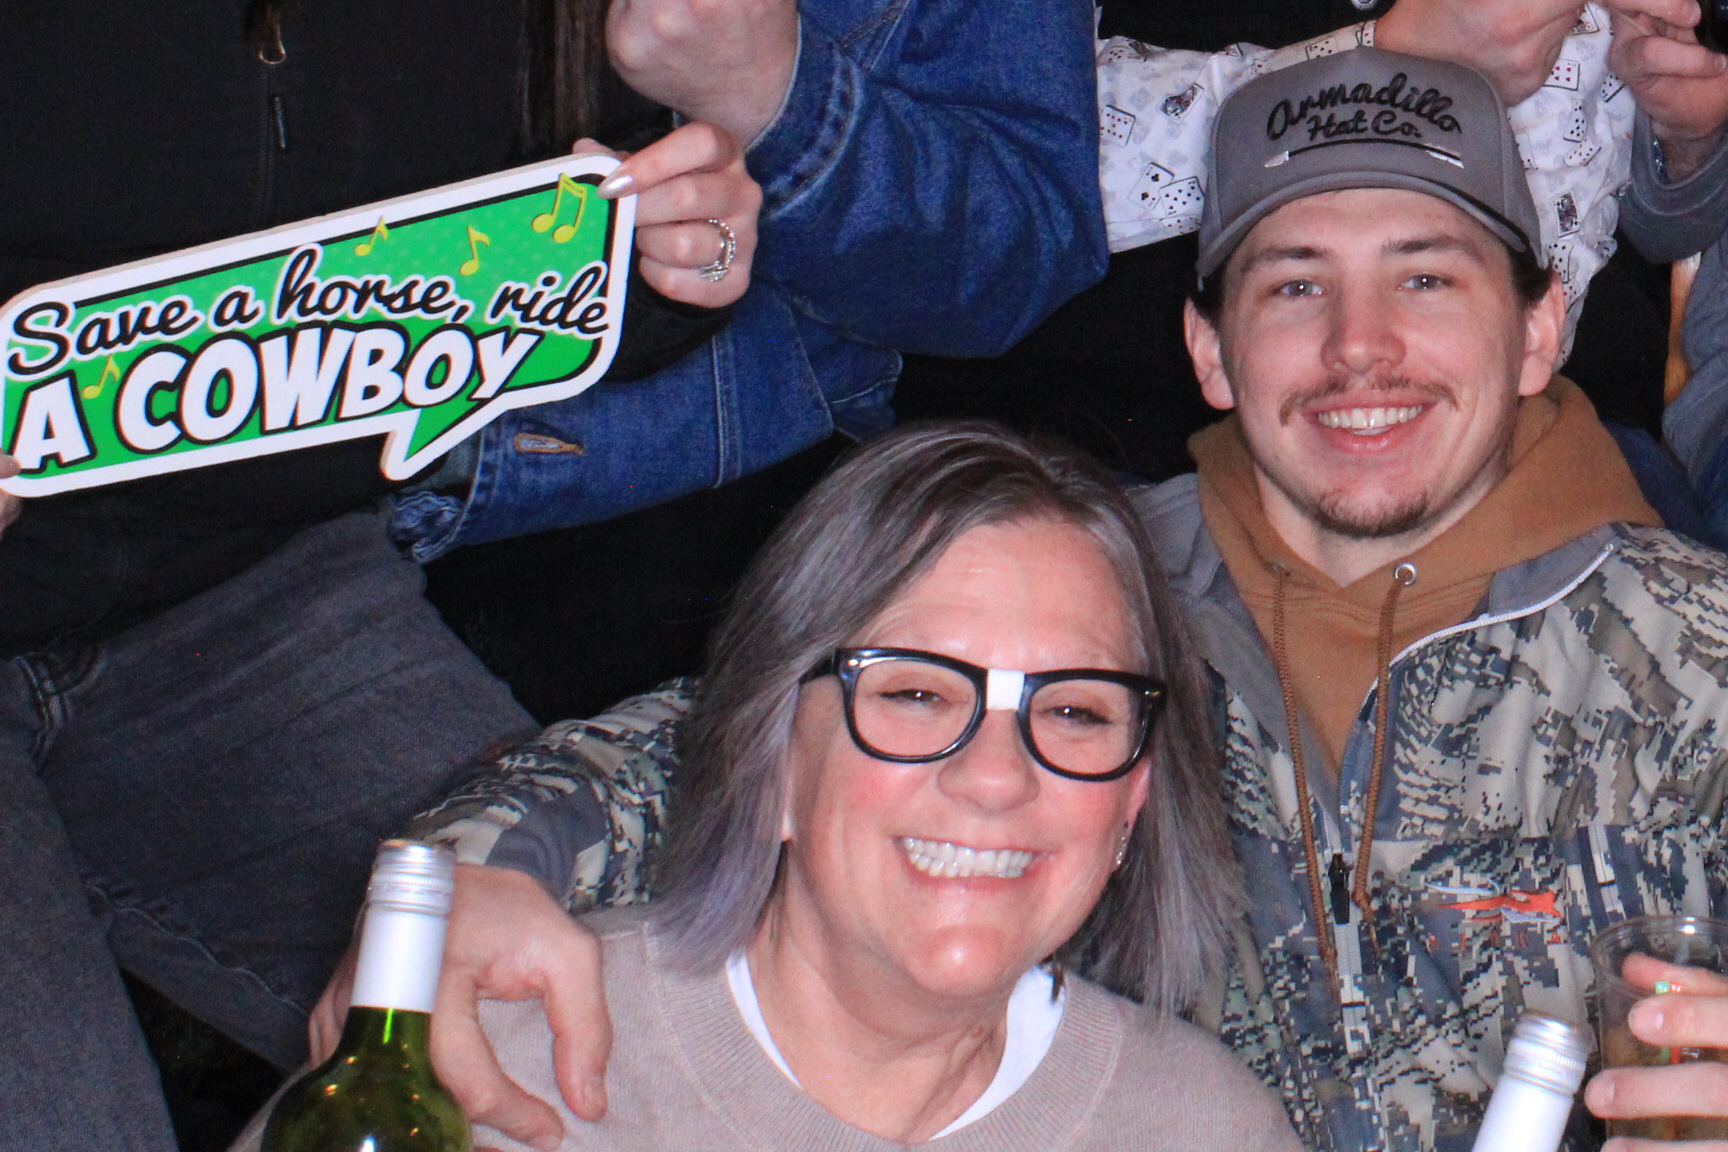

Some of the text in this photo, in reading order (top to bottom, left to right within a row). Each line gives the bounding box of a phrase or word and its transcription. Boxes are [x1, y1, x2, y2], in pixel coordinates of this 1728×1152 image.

[1266, 72, 1462, 140] Armadillo
[1307, 109, 1422, 140] Hat Co.
[9, 247, 609, 375] Save a horse, ride
[15, 320, 543, 473] A COWBOY
